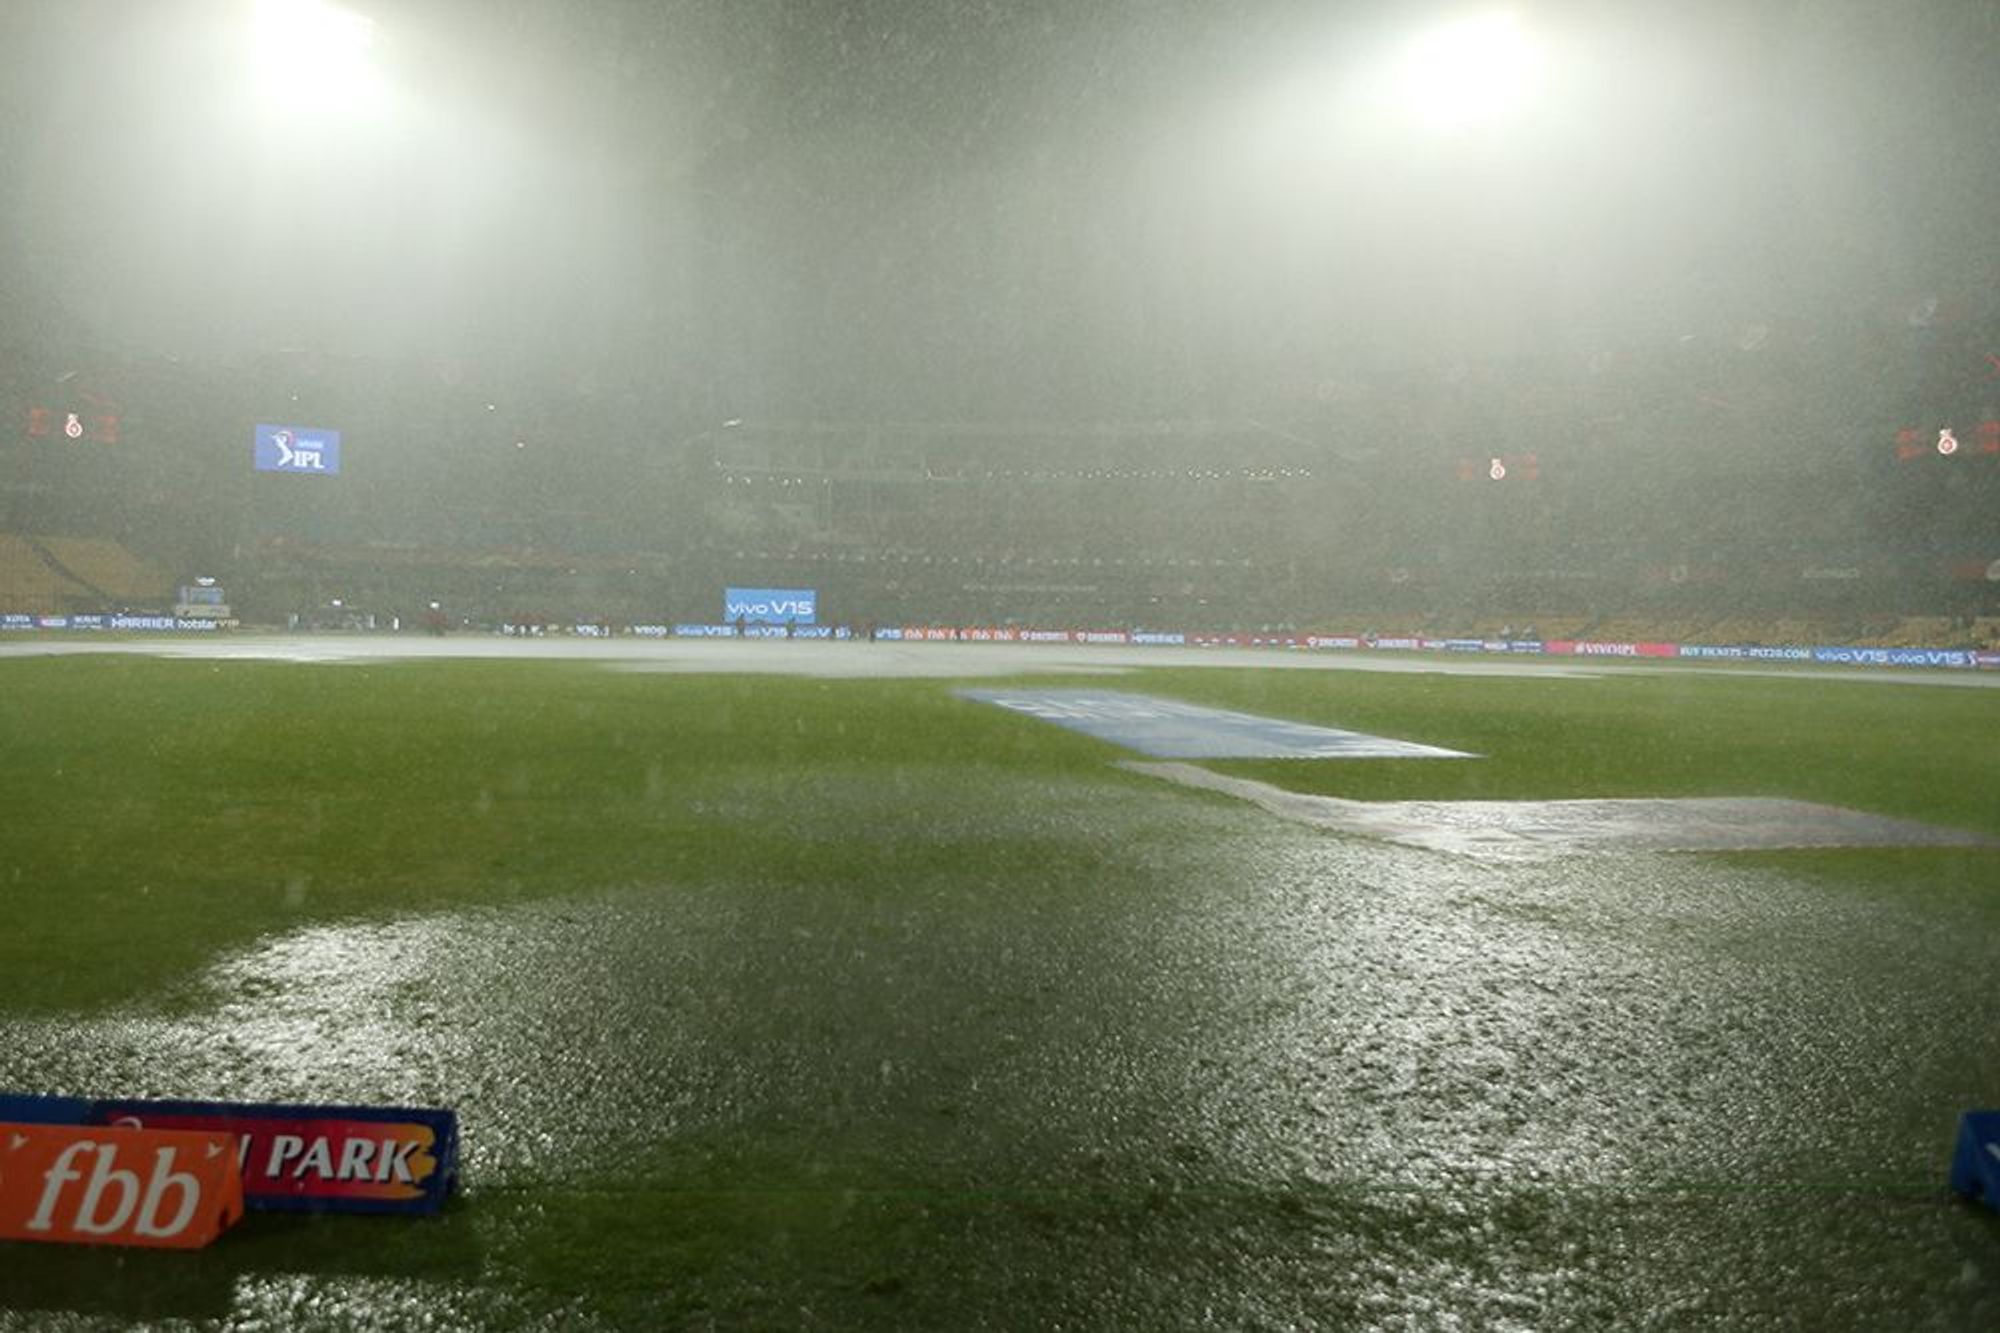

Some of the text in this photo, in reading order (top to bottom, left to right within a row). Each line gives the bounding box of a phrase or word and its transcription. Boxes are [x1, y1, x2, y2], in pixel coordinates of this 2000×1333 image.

[293, 451, 325, 468] IPL
[727, 601, 814, 615] vivo V15
[177, 618, 216, 629] hotstar
[1816, 650, 1888, 662] vivo V15
[1891, 653, 1925, 664] vivo
[1926, 651, 1964, 665] V15
[265, 1134, 420, 1184] PARK
[27, 1139, 201, 1238] fbb
